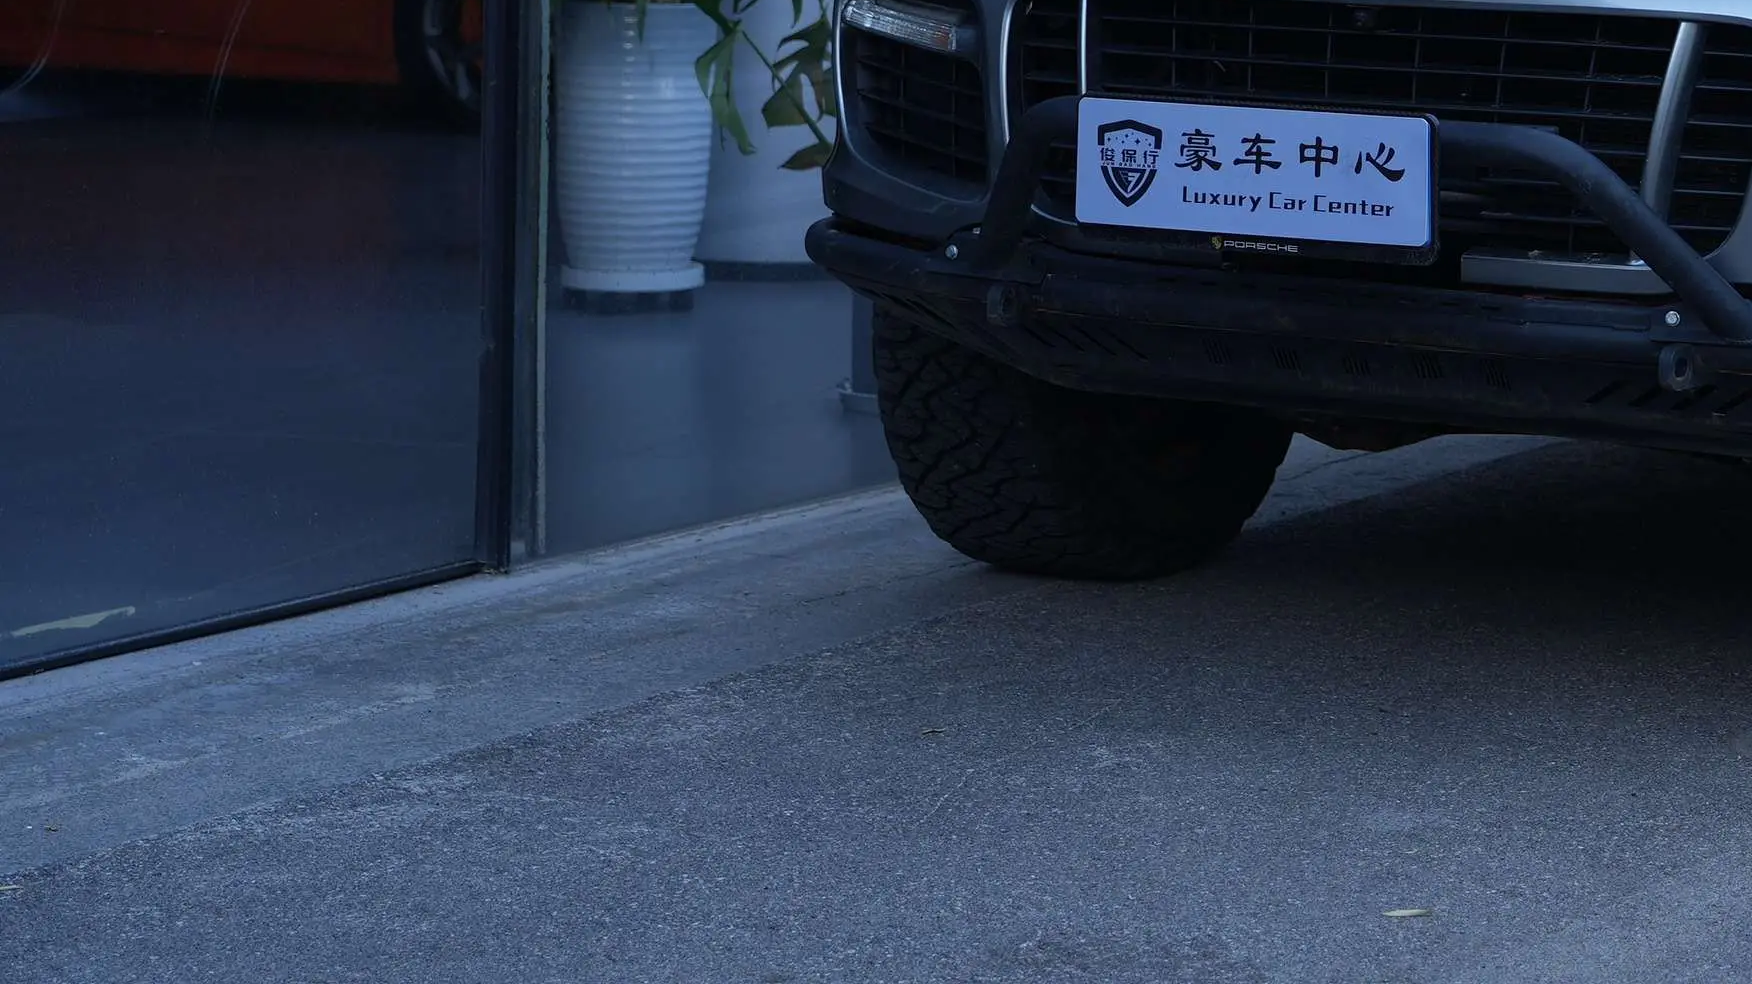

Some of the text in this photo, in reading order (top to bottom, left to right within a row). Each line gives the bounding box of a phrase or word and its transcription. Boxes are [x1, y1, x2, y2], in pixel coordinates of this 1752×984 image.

[1100, 147, 1160, 165] 俊保行
[1174, 128, 1406, 183] 豪车中心
[1182, 185, 1395, 217] Luxury Car Center
[1224, 240, 1299, 253] PORSCHE
